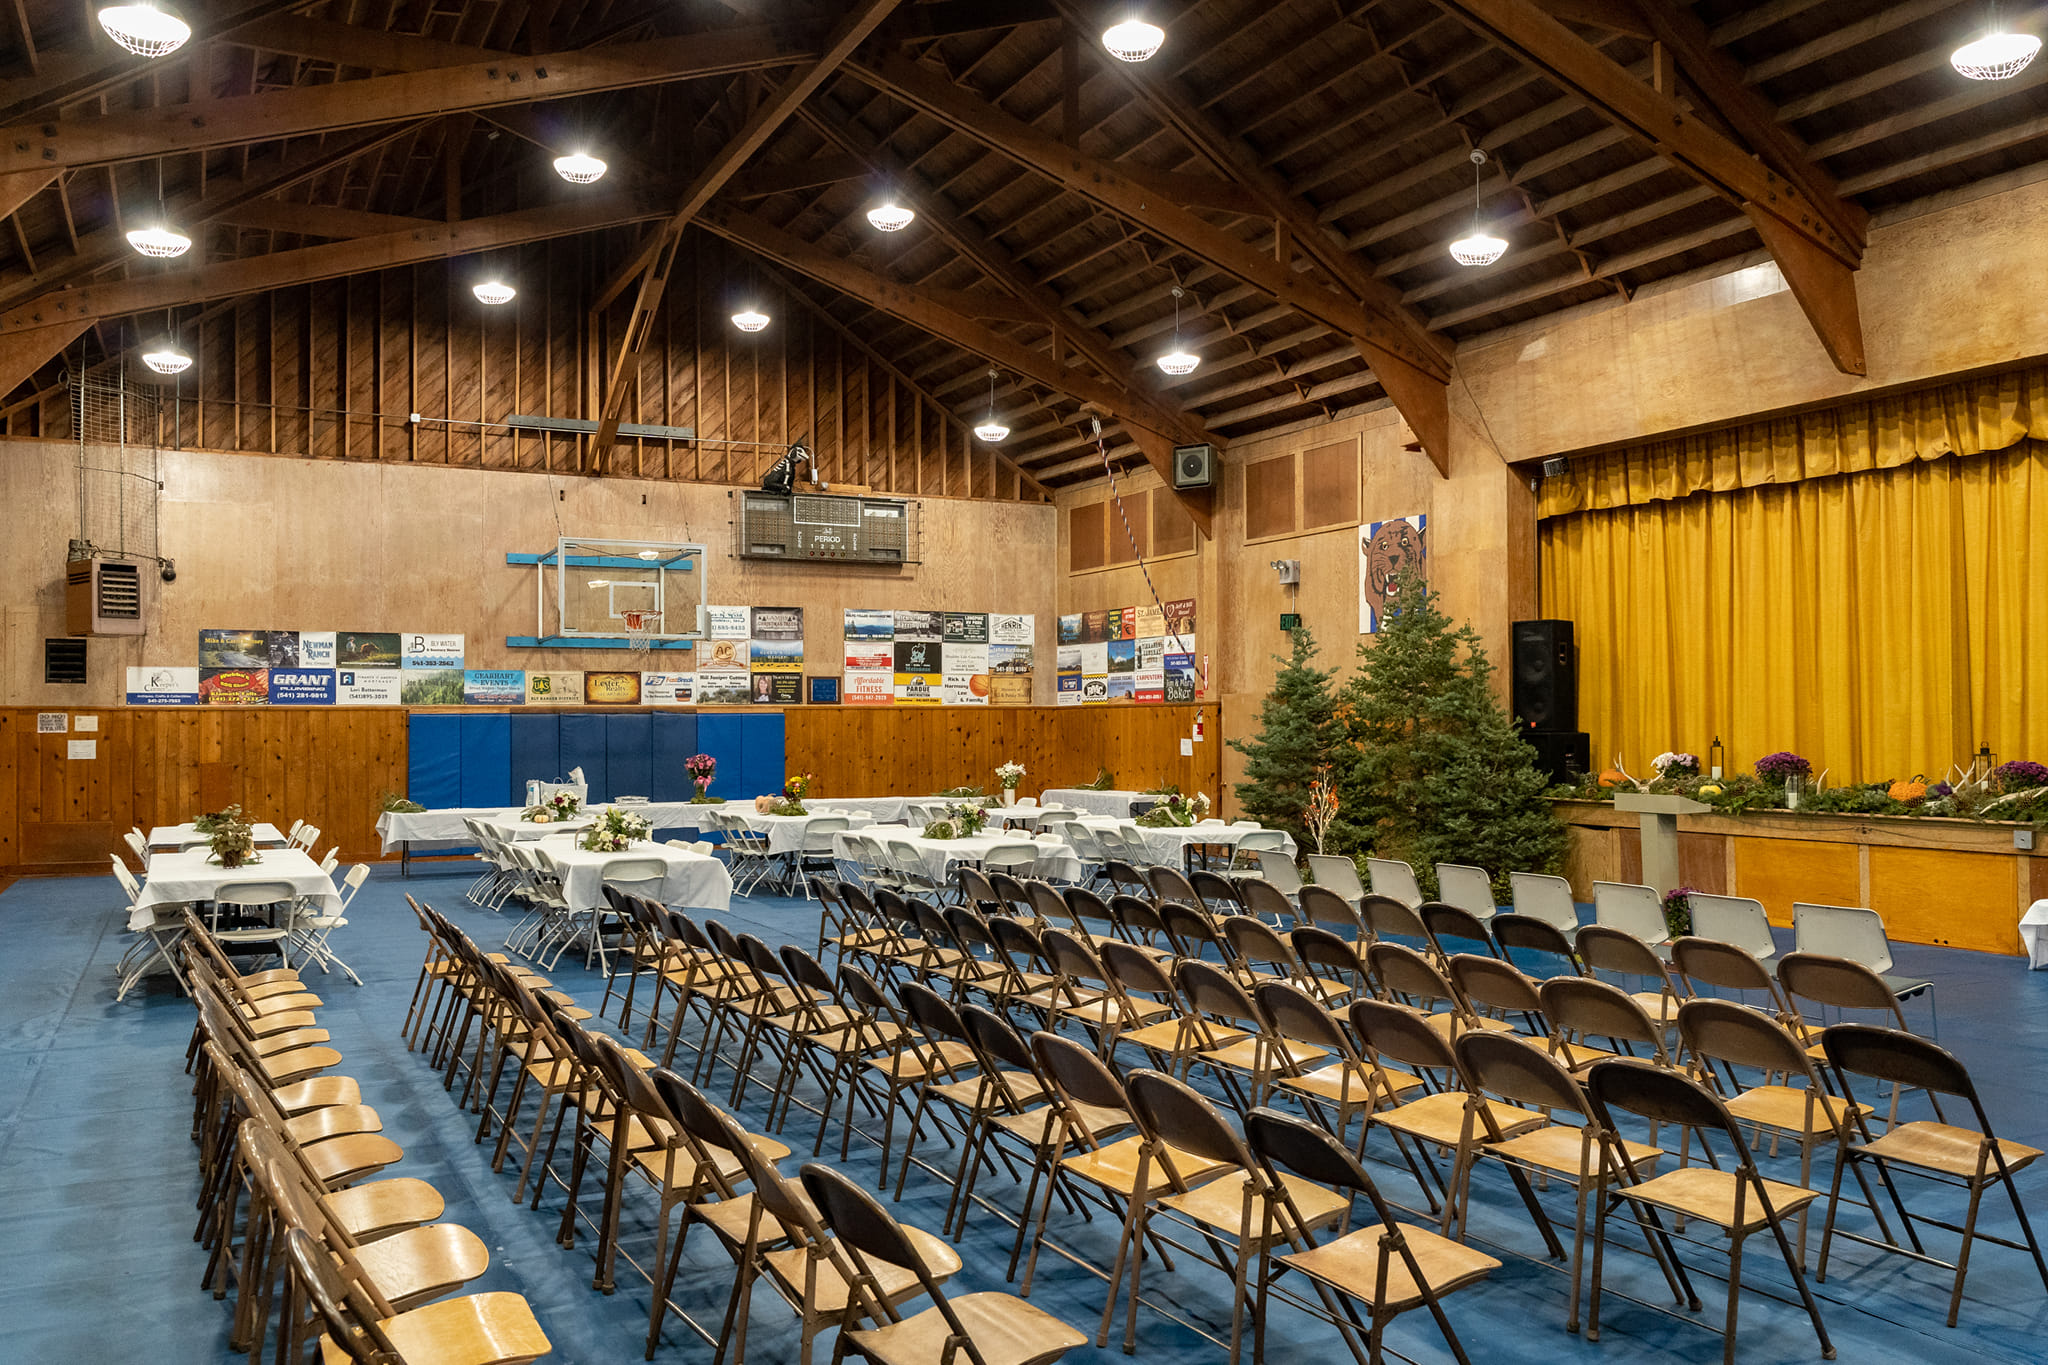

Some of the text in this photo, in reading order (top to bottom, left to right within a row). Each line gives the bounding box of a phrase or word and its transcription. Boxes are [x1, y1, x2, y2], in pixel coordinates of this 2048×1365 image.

[814, 535, 841, 543] PERIOD
[302, 640, 333, 651] NEWMAN
[440, 640, 457, 648] WATER
[306, 650, 330, 660] RANCH
[273, 674, 332, 686] GRANT
[474, 672, 515, 680] GEARHART
[855, 685, 883, 693] FITNESS
[1167, 686, 1192, 700] Baker
[276, 692, 295, 700] (541)
